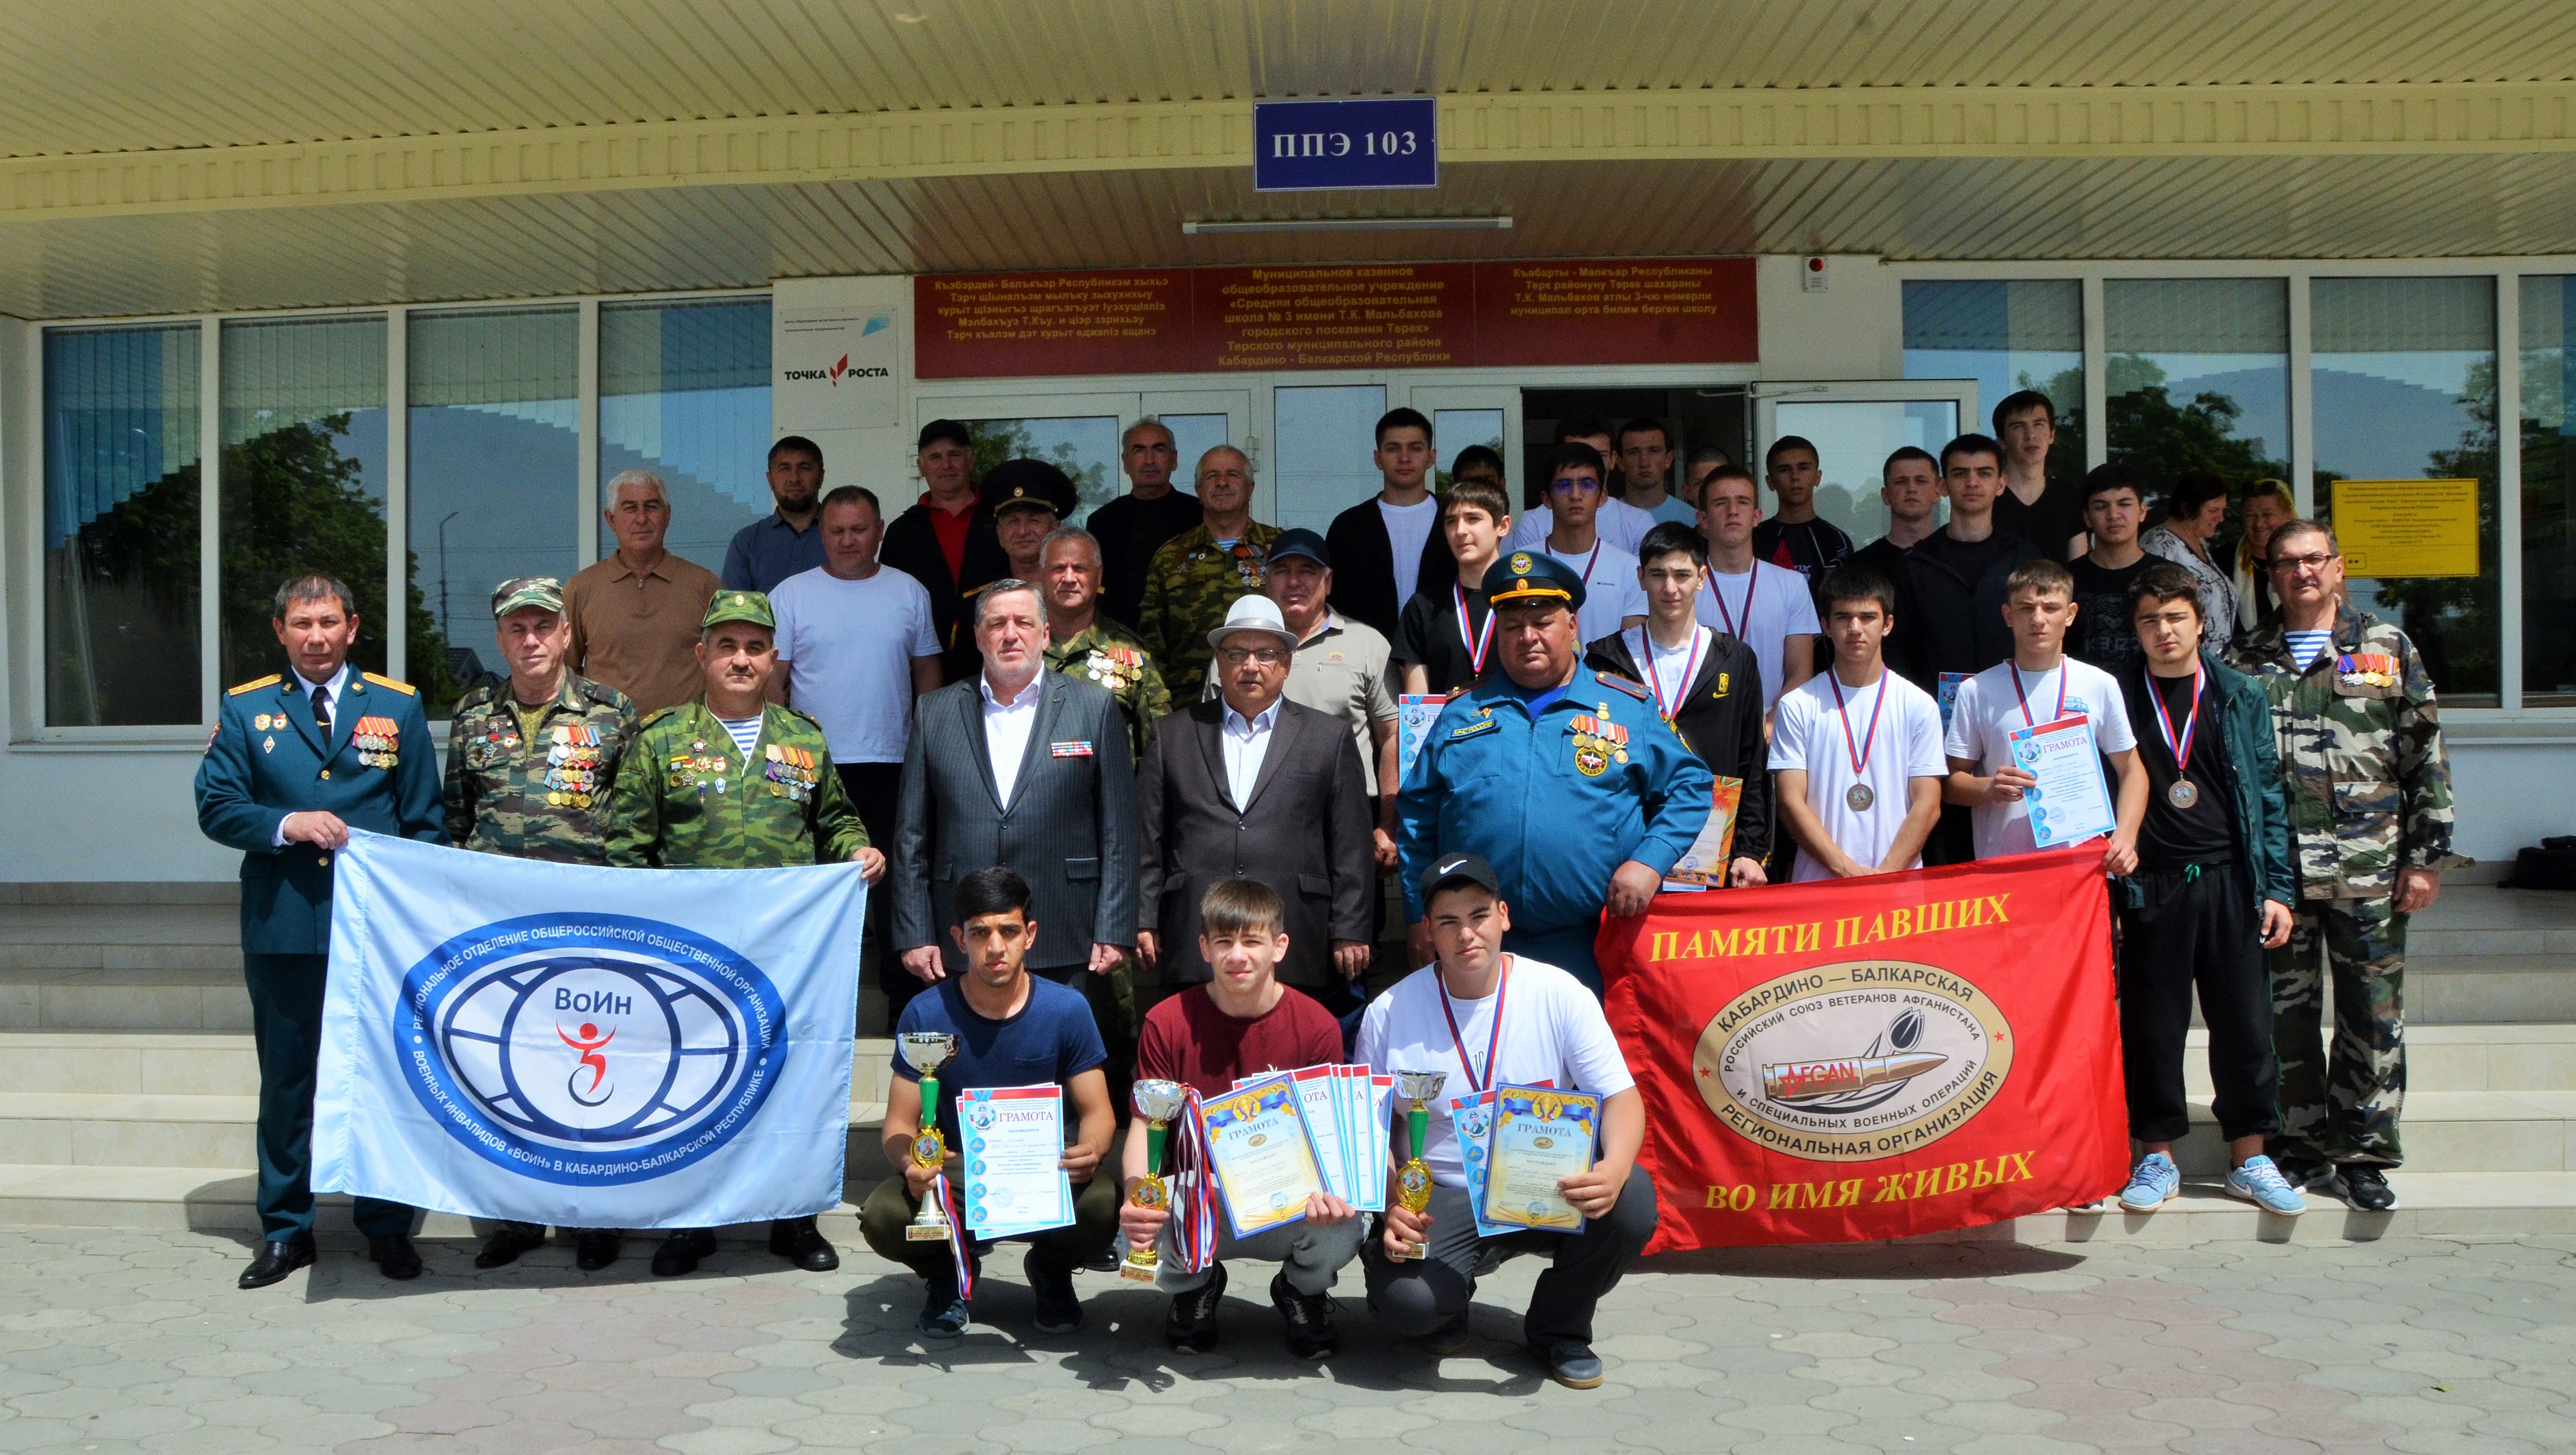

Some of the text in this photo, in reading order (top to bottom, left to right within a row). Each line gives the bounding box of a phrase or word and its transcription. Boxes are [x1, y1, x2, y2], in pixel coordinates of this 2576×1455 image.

[1272, 130, 1417, 157] ППЭ 103
[1252, 268, 1413, 281] Муниципальное казенное
[1631, 266, 1712, 277] Республиканы
[1222, 281, 1444, 295] общеобразовательное учреждение
[1230, 295, 1437, 310] «Средняя общеобразовательная
[1225, 314, 1264, 323] школа
[1268, 311, 1281, 322] №
[1285, 311, 1292, 321] 3
[1296, 312, 1335, 321] имени
[1365, 308, 1443, 319] Мальбахова
[1242, 322, 1429, 338] городского поселения Терек»
[1226, 338, 1442, 353] Терского муниципального района
[1218, 354, 1286, 367] Кабардино
[1298, 352, 1372, 366] Балкарской
[1375, 351, 1451, 364] Республики
[785, 367, 888, 380] ТОЧКА РОСТА
[2043, 737, 2087, 753] ГРАМОТА
[1649, 893, 2011, 963] ПАМЯТИ ПАВШИХ
[413, 924, 772, 1049] РЕГИОНАЛЬНОЕ ОТДЕЛЕНИЕ ОБЩЕРОССИЙСКОЙ ОБЩЕСТВЕННОЙ ОРГАНИЗАЦИИ
[554, 987, 632, 1015] ВоИн
[1718, 974, 1824, 1033] КАБАРДИНО
[1851, 967, 1973, 1002] БАЛКАРСКАЯ
[1724, 993, 1980, 1072] РОССИЙСКИЙ СОЮЗ ВЕТЕРАНОВ АФГАНИСТАНА
[1780, 1061, 1856, 1098] AFGAN
[1737, 1059, 1977, 1128] И СПЕЦИАЛЬНЫХ ВОЕННЫХ ОПЕРАЦИЙ
[413, 1050, 764, 1176] ВОЕННЫХ ИНВАЛИДОВ «ВОИН» В КАБАРДИНО-БАЛКАРСКОЙ РЕСПУБЛИКЕ
[1000, 1111, 1053, 1122] ГРАМОТА
[1721, 1071, 1998, 1155] РЕГИОНАЛЬНАЯ ОРГАНИЗАЦИЯ
[1228, 1117, 1279, 1140] ГРАМОТА
[1517, 1123, 1571, 1137] ГРАМОТА
[1704, 1150, 2036, 1212] ВО ИМЯ ЖИВЫХ
